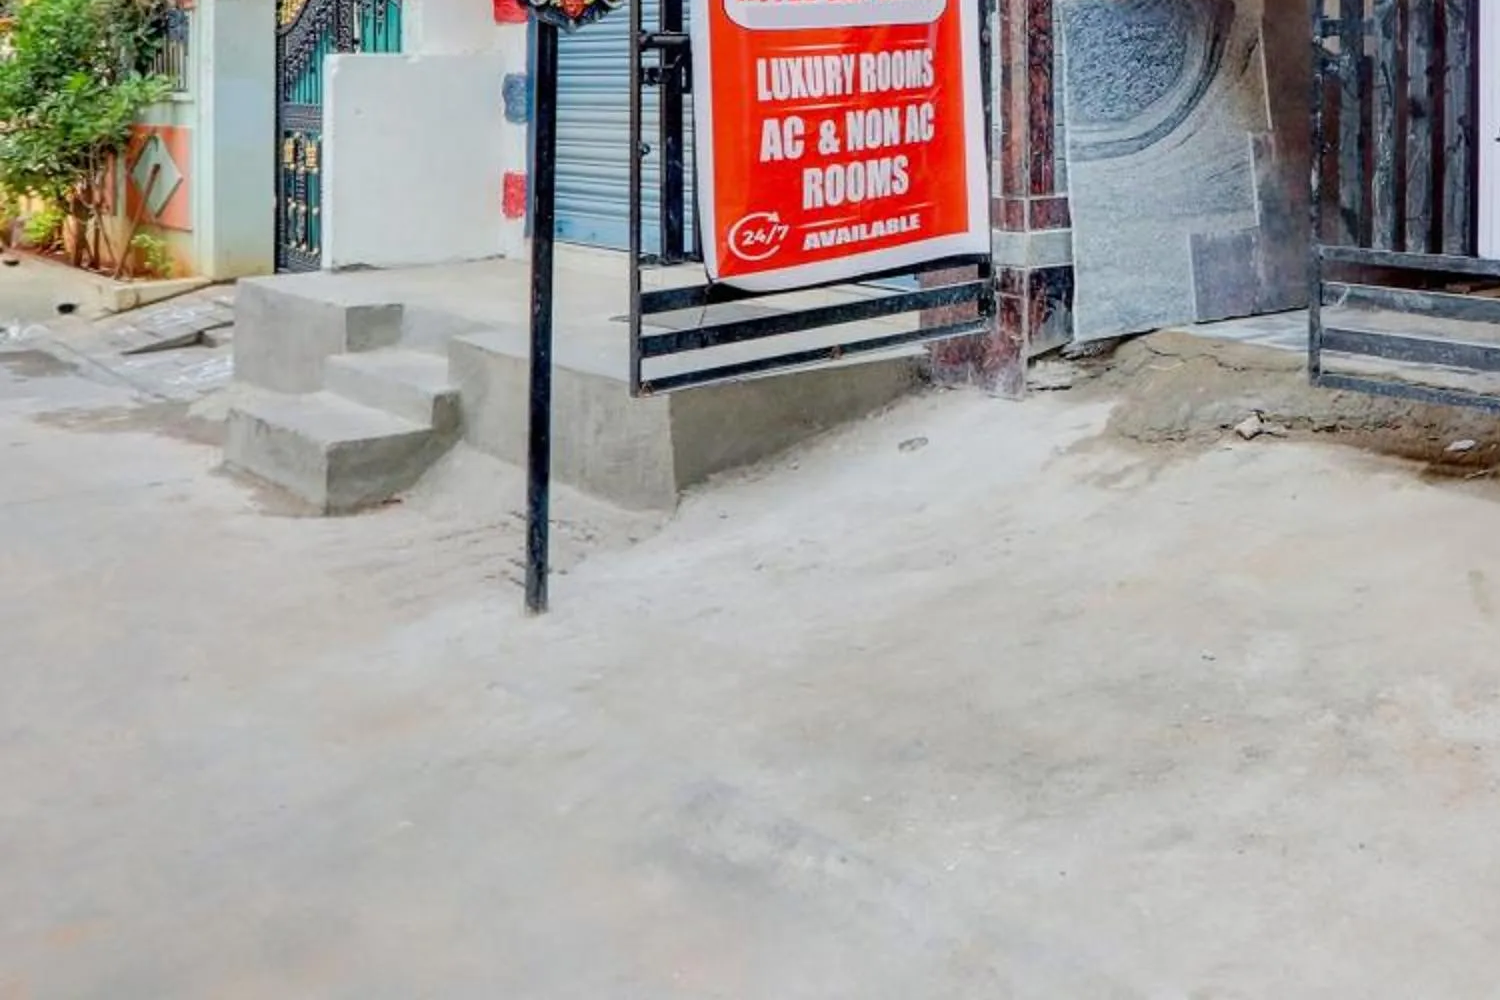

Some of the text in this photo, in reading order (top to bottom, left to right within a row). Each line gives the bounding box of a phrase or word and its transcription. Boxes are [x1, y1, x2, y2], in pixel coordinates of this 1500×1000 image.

[756, 48, 935, 102] LUXURY ROOMS
[759, 102, 935, 162] AC & NON AC
[803, 155, 910, 210] ROOMS
[741, 213, 920, 251] 24/7 AVAILABLE
